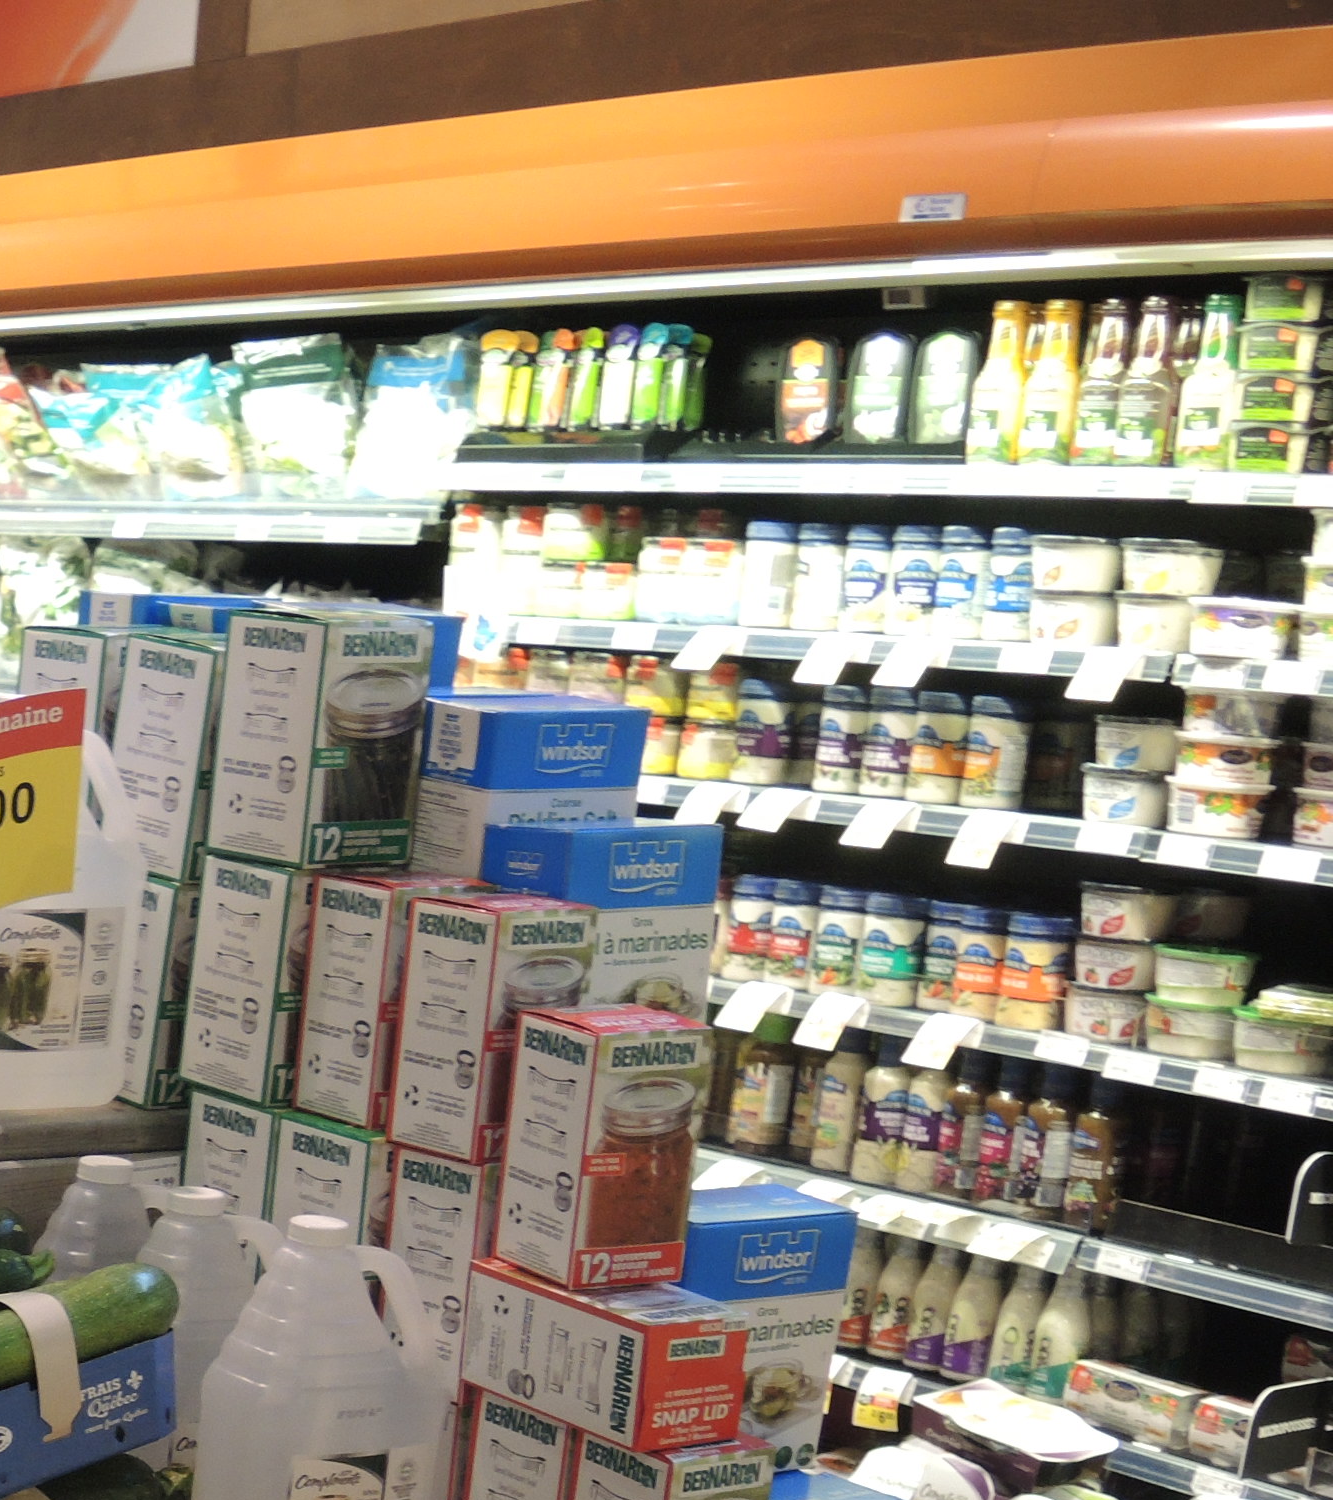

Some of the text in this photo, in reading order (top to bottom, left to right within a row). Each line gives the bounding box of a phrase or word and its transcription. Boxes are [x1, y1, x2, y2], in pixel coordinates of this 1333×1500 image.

[540, 738, 608, 763] windsor
[613, 855, 680, 881] windsor
[617, 931, 709, 954] marinades
[611, 1041, 697, 1068] BERNARDIN
[580, 1252, 611, 1285] 12
[741, 1243, 813, 1272] windsor
[80, 1377, 121, 1400] FRAIS
[651, 1403, 729, 1429] SNAP LID
[294, 1469, 362, 1491] Compliments
[682, 1461, 762, 1493] BERNARDIN
